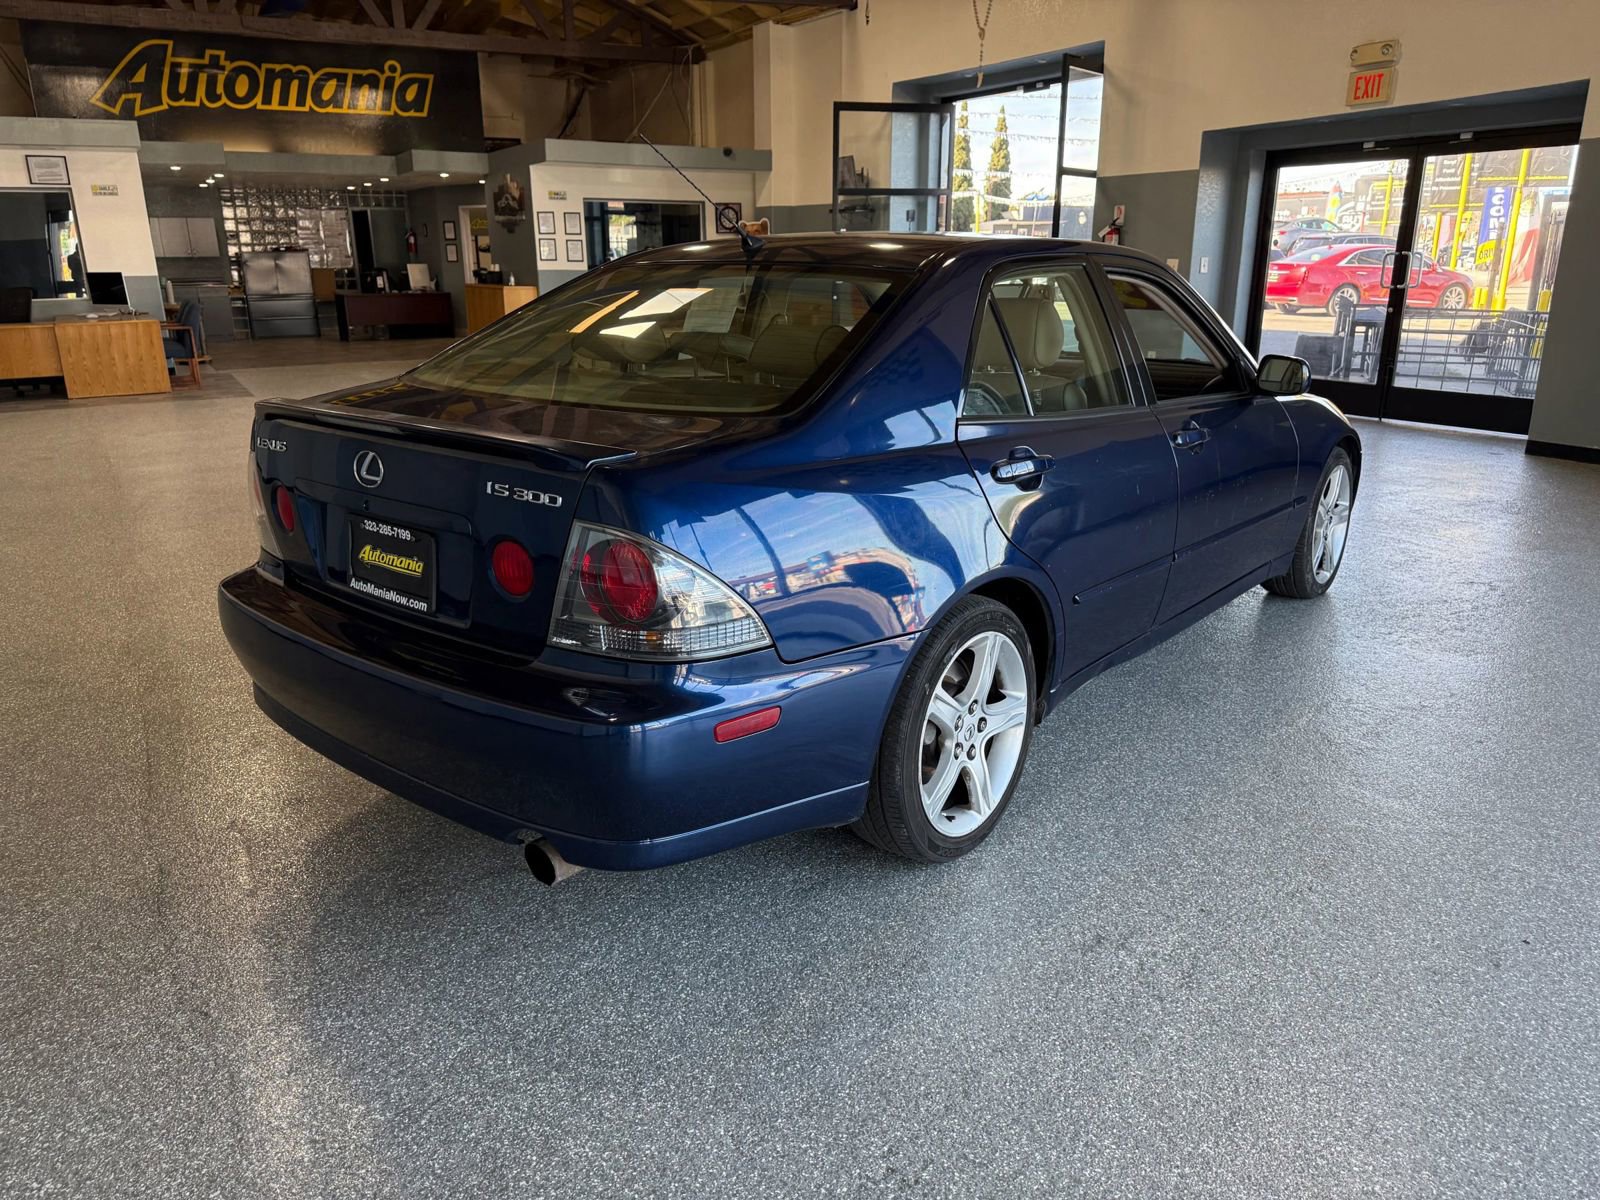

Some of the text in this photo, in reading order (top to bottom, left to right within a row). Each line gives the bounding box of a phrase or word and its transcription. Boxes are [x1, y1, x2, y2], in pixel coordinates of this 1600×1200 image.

[89, 39, 434, 118] Automania
[1353, 72, 1385, 101] EXIT
[257, 436, 287, 452] LEXUS
[486, 481, 563, 508] IS 300
[363, 519, 411, 541] 323-285-7199
[359, 543, 424, 573] Automania
[350, 577, 428, 612] AutoManiaNow.com
